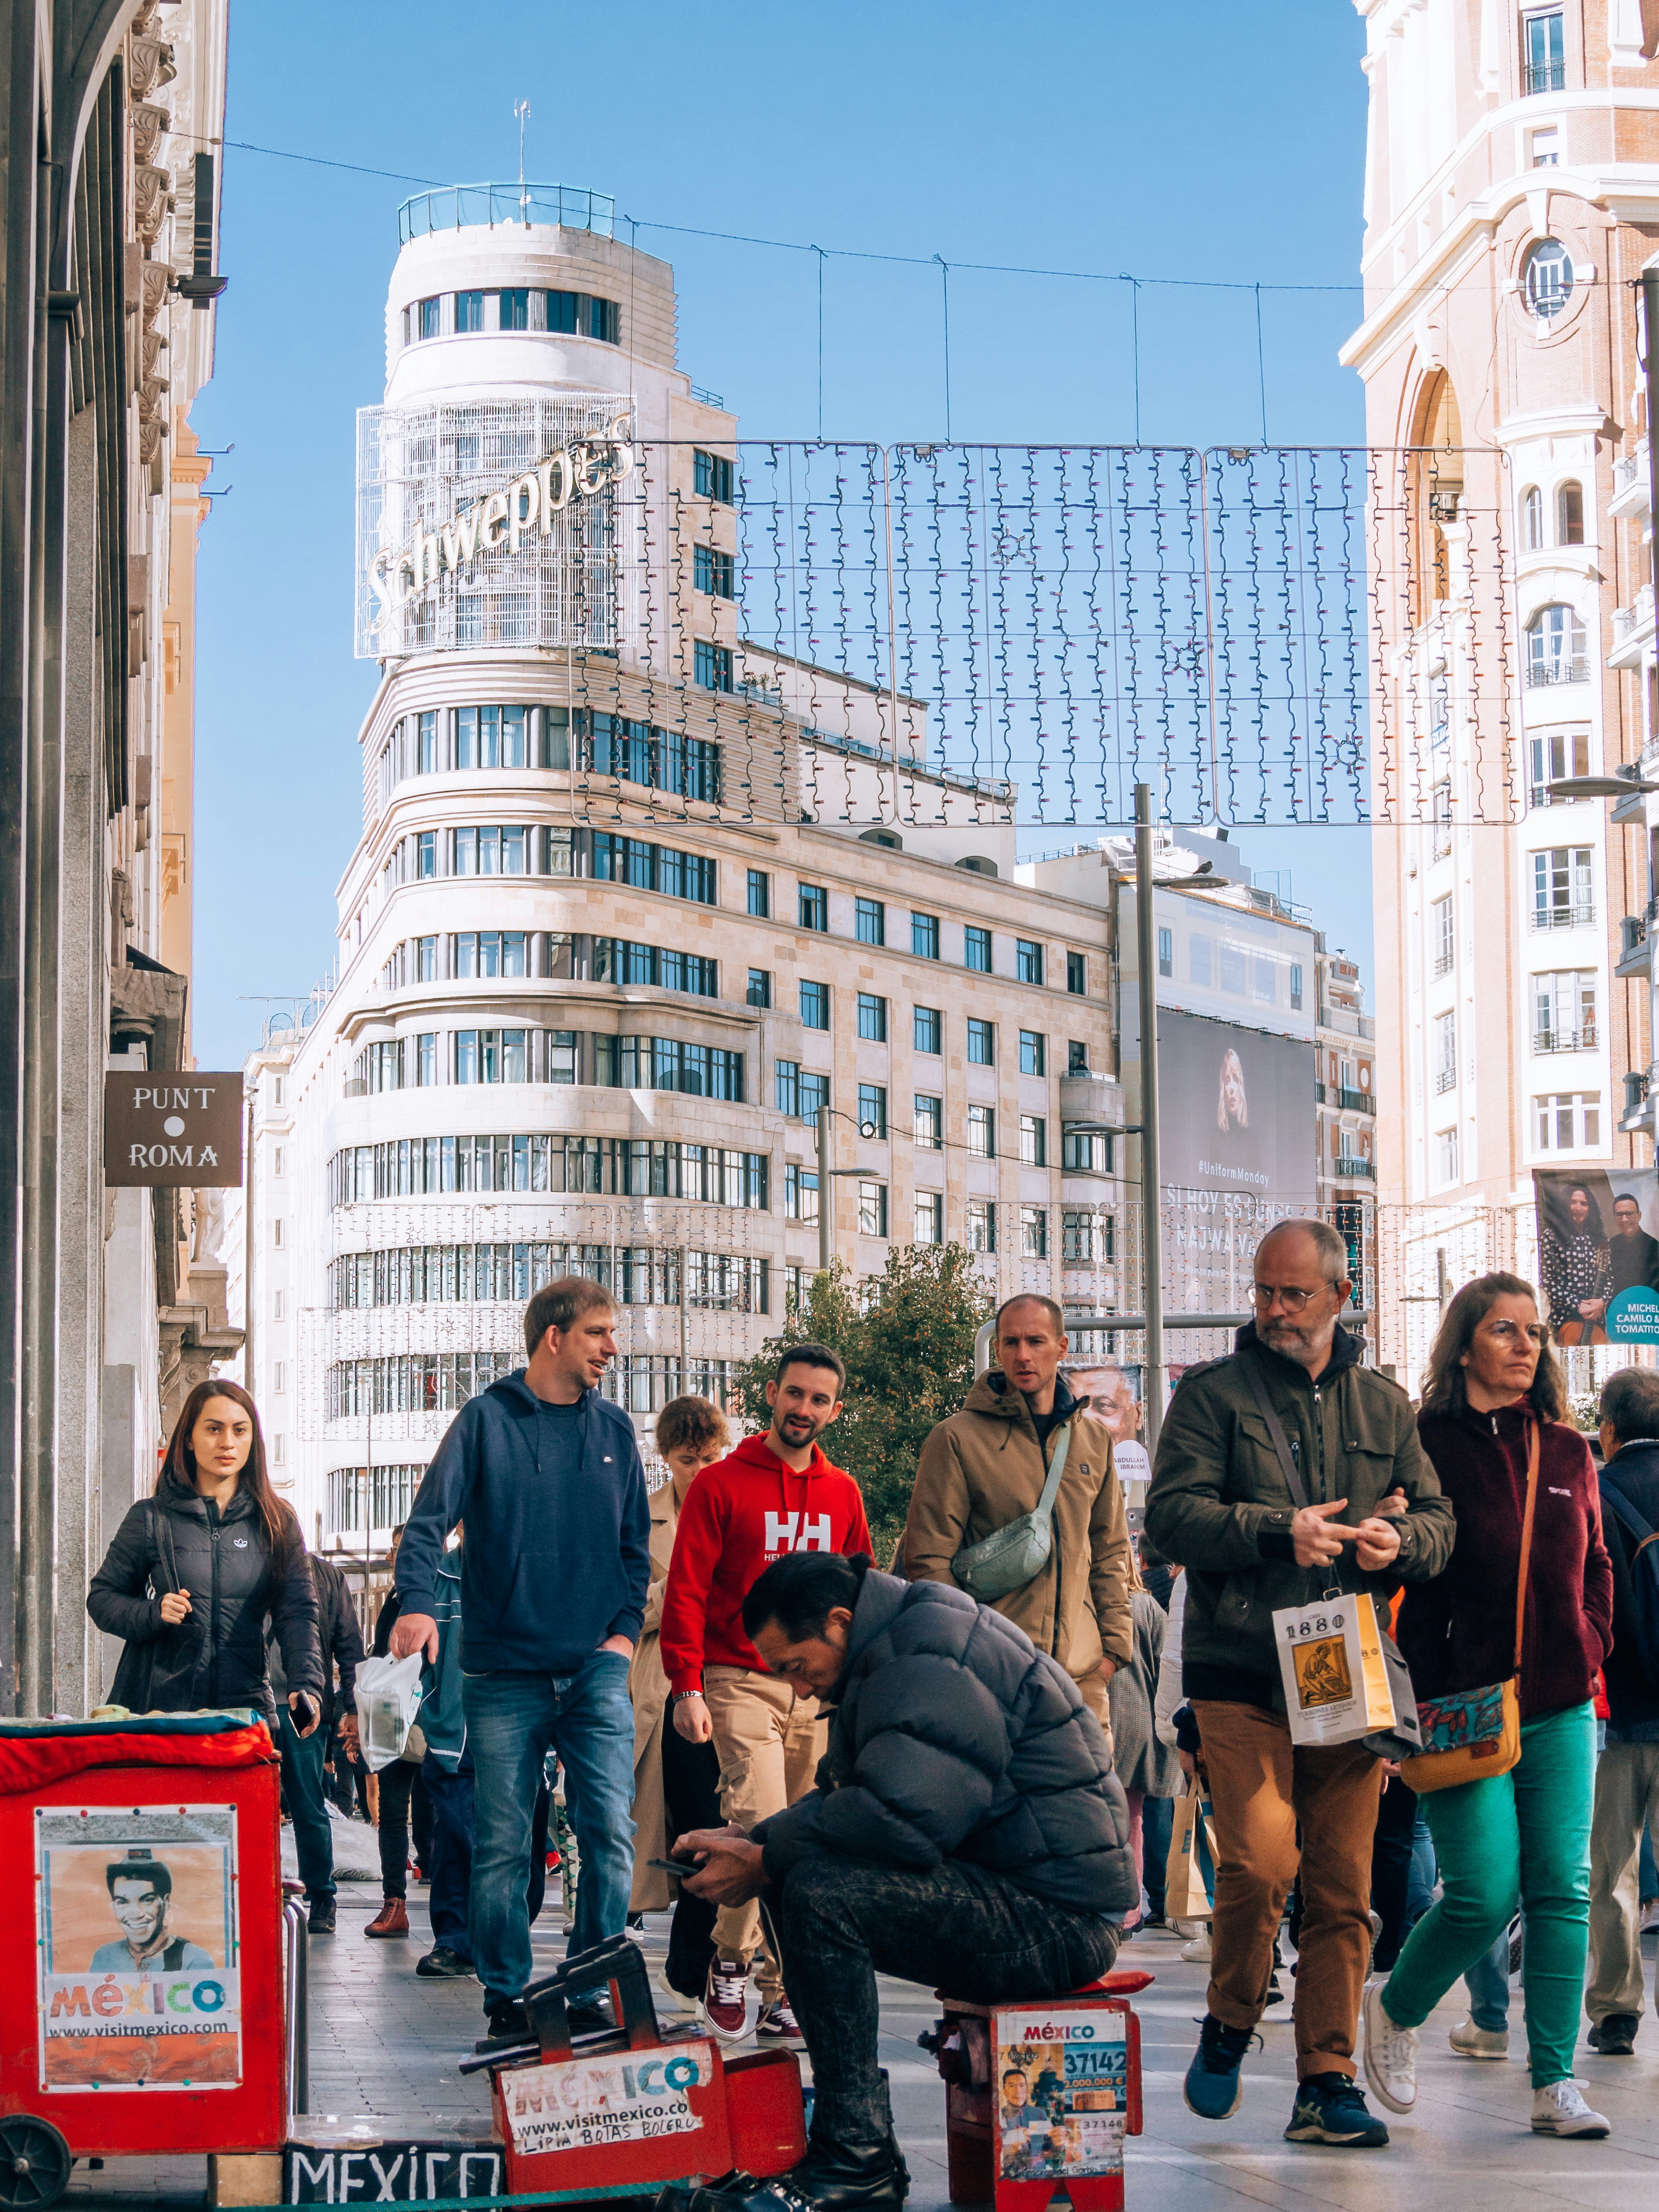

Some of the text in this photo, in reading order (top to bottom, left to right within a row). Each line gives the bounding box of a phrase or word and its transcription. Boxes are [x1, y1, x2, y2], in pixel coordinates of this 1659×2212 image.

[368, 412, 634, 635] Schweppes
[133, 1087, 216, 1109] PUNT
[128, 1144, 219, 1168] ROMA
[1198, 1160, 1269, 1187] #UniformMonday
[1167, 1183, 1181, 1209] SI
[1187, 1186, 1219, 1214] HOY
[1616, 1314, 1653, 1323] CAMILO
[1628, 1303, 1659, 1313] MICHEL
[1615, 1325, 1659, 1334] TOMATITO
[764, 1512, 830, 1552] HH
[1286, 1615, 1344, 1639] 1880
[50, 2021, 228, 2037] www.visitmexico.com
[1065, 2051, 1126, 2074] 37142
[1063, 2077, 1113, 2089] 2.000.000
[1083, 2120, 1122, 2129] 37148
